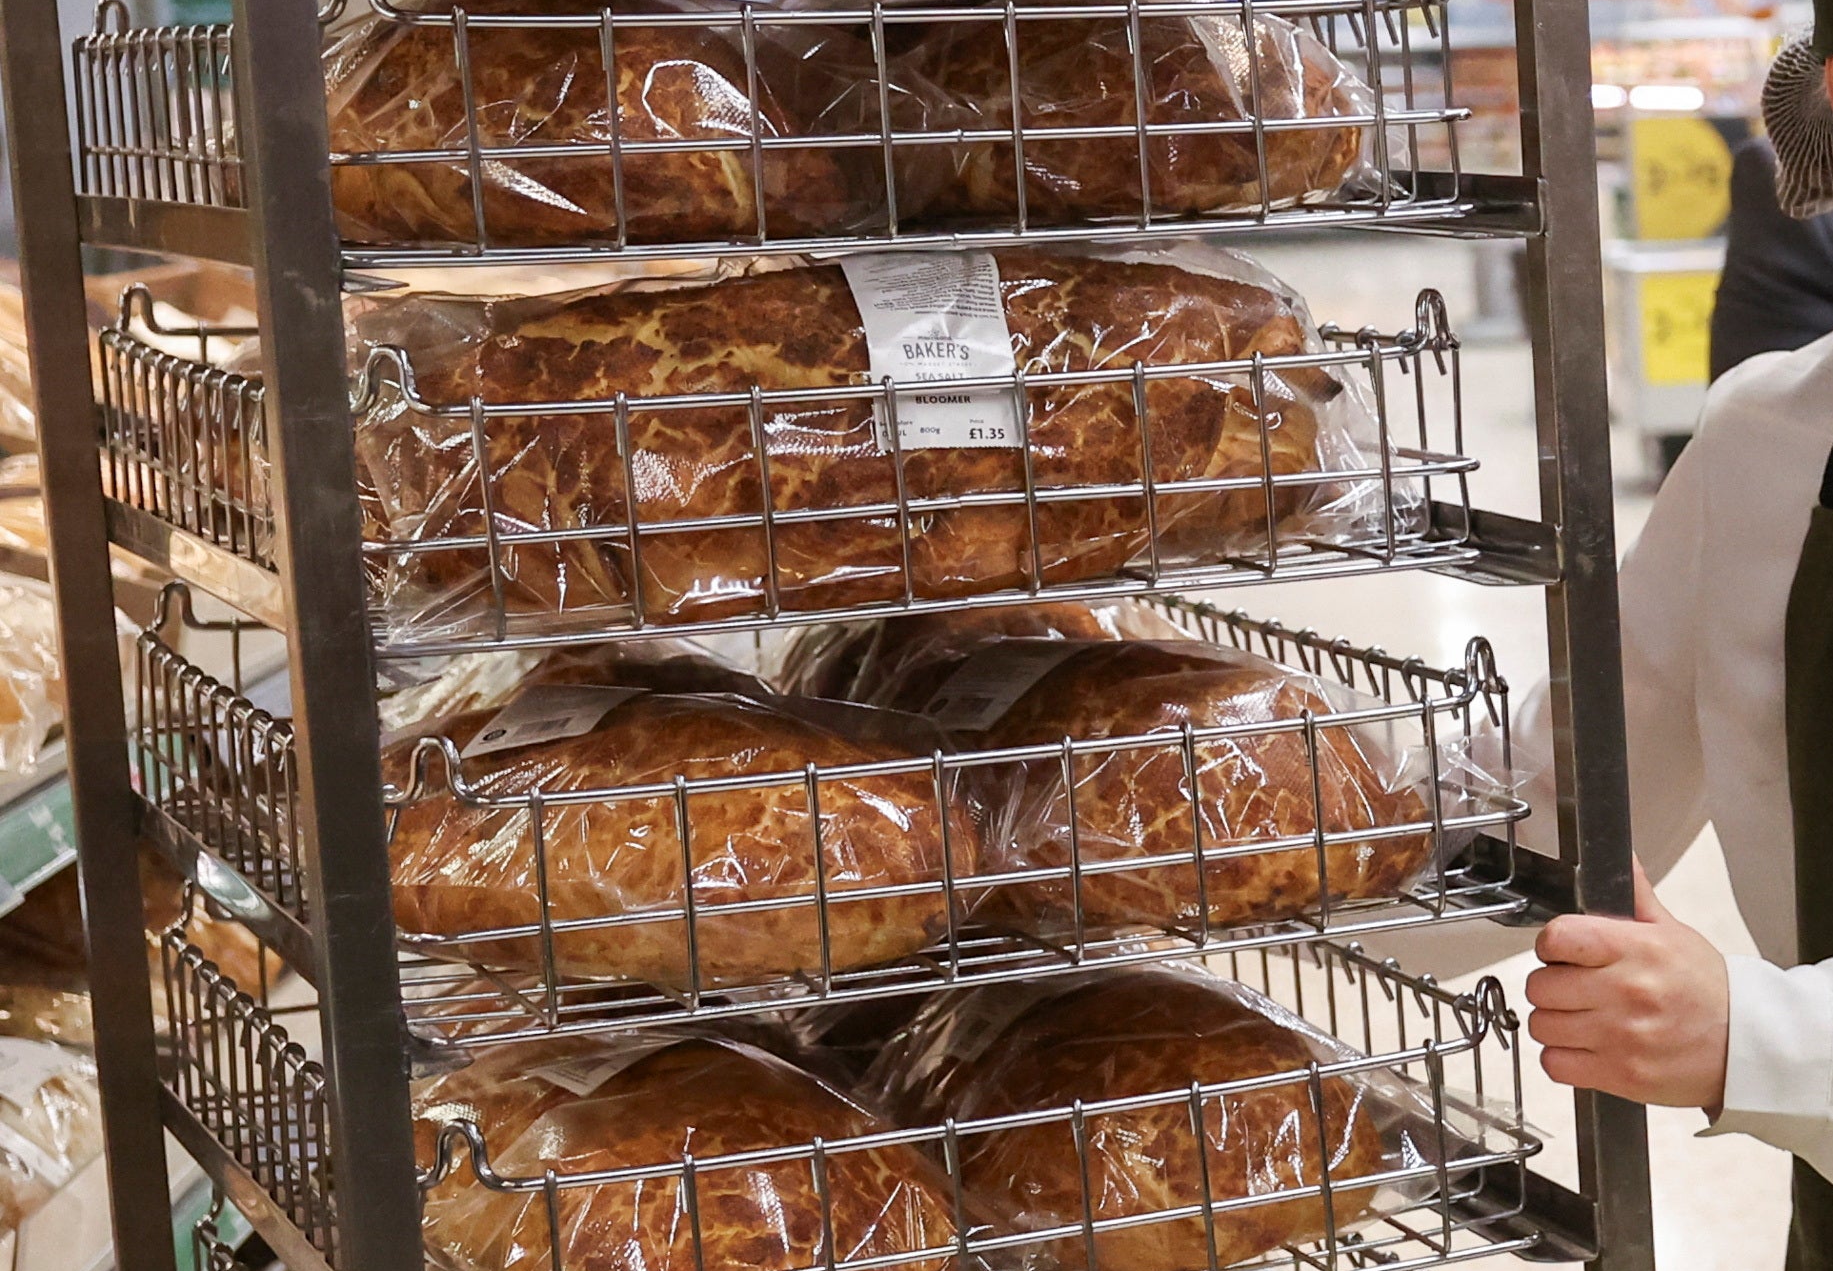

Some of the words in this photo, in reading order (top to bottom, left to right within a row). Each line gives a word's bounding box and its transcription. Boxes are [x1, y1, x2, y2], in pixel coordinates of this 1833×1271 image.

[902, 343, 971, 361] BAKER'S
[915, 395, 972, 404] BLOOMER
[969, 427, 1005, 440] £1.35
